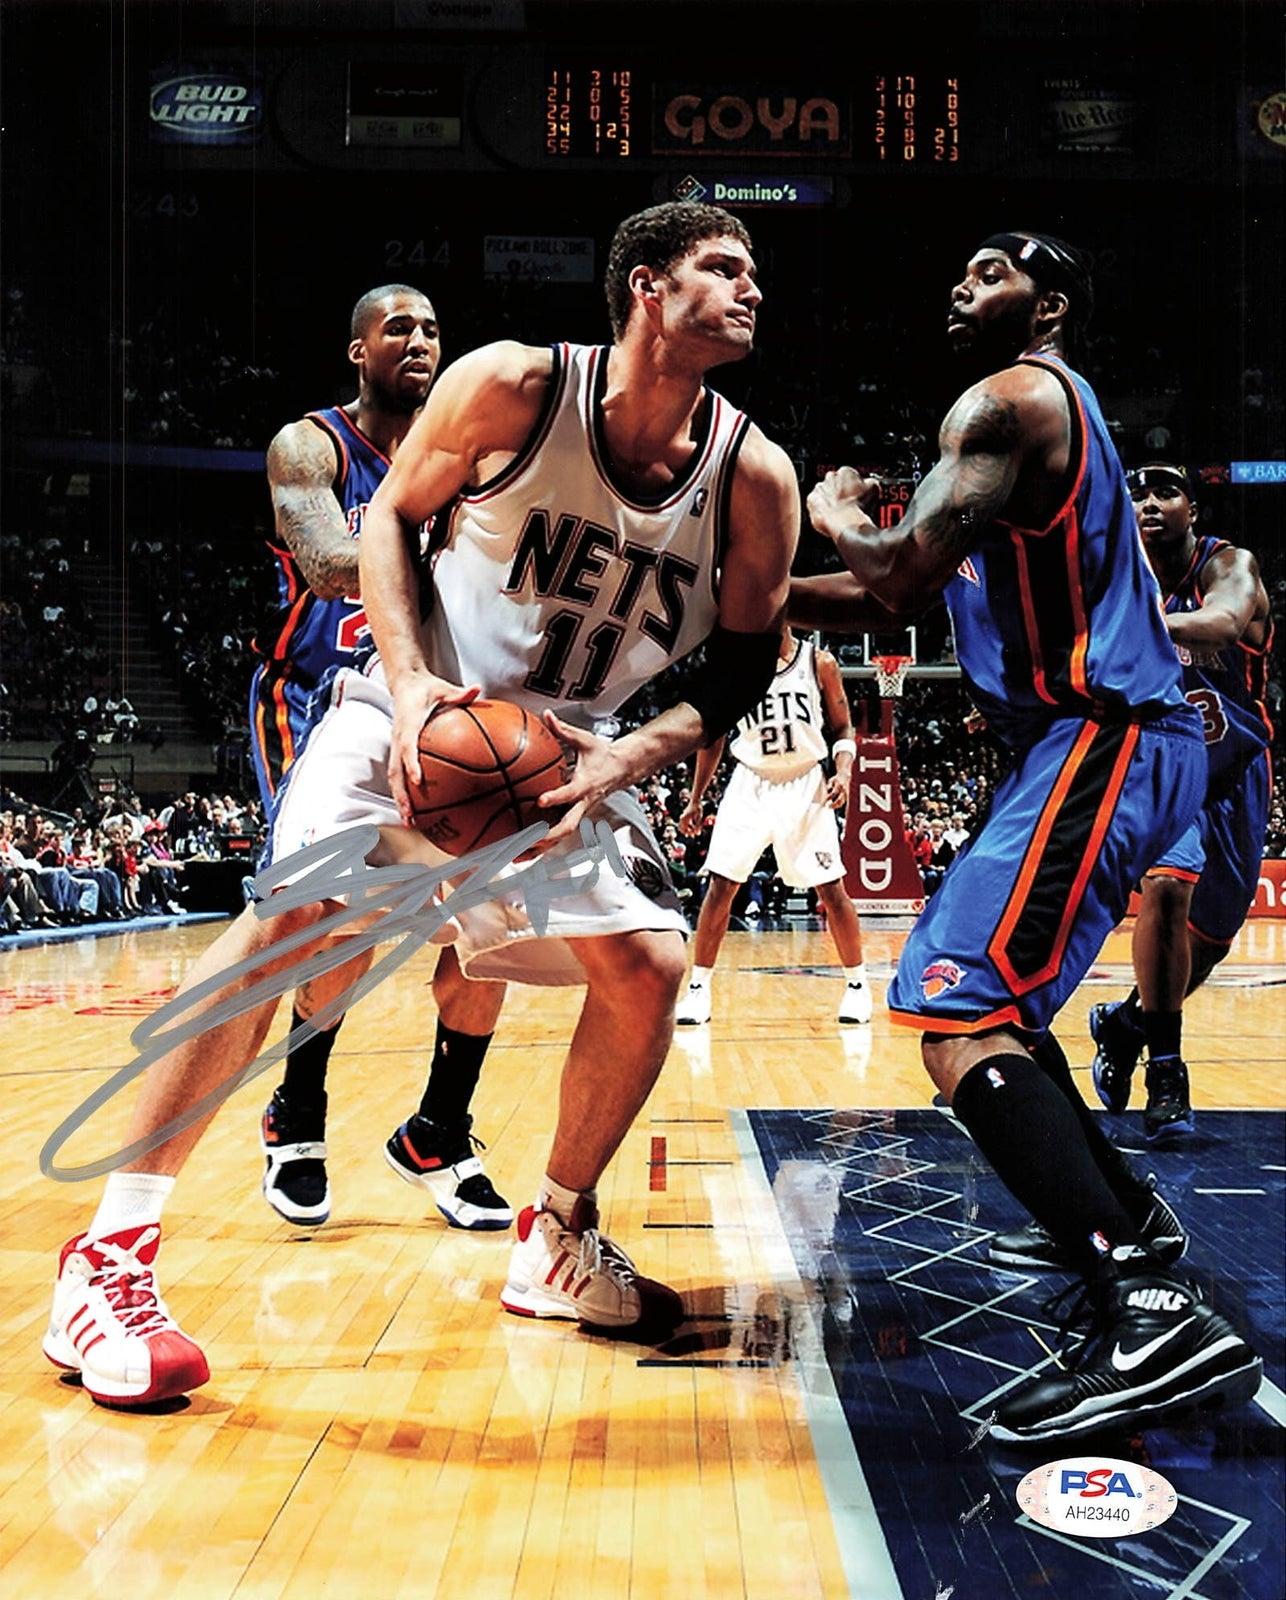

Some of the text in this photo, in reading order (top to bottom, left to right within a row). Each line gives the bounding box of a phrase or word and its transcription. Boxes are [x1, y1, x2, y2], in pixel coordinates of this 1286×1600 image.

[612, 71, 631, 87] 10
[174, 84, 248, 102] BUD
[157, 103, 256, 123] LIGHT
[547, 104, 570, 120] 22
[664, 94, 840, 145] GOYA
[547, 121, 570, 137] 34
[619, 139, 630, 156] 3
[714, 183, 797, 201] Domino's
[384, 240, 451, 269] 244
[500, 508, 700, 657] NETS
[524, 608, 626, 701] 11
[743, 692, 811, 730] NETS
[761, 724, 797, 756] 21
[859, 756, 892, 892] IZOD
[1126, 1288, 1189, 1311] NIKE
